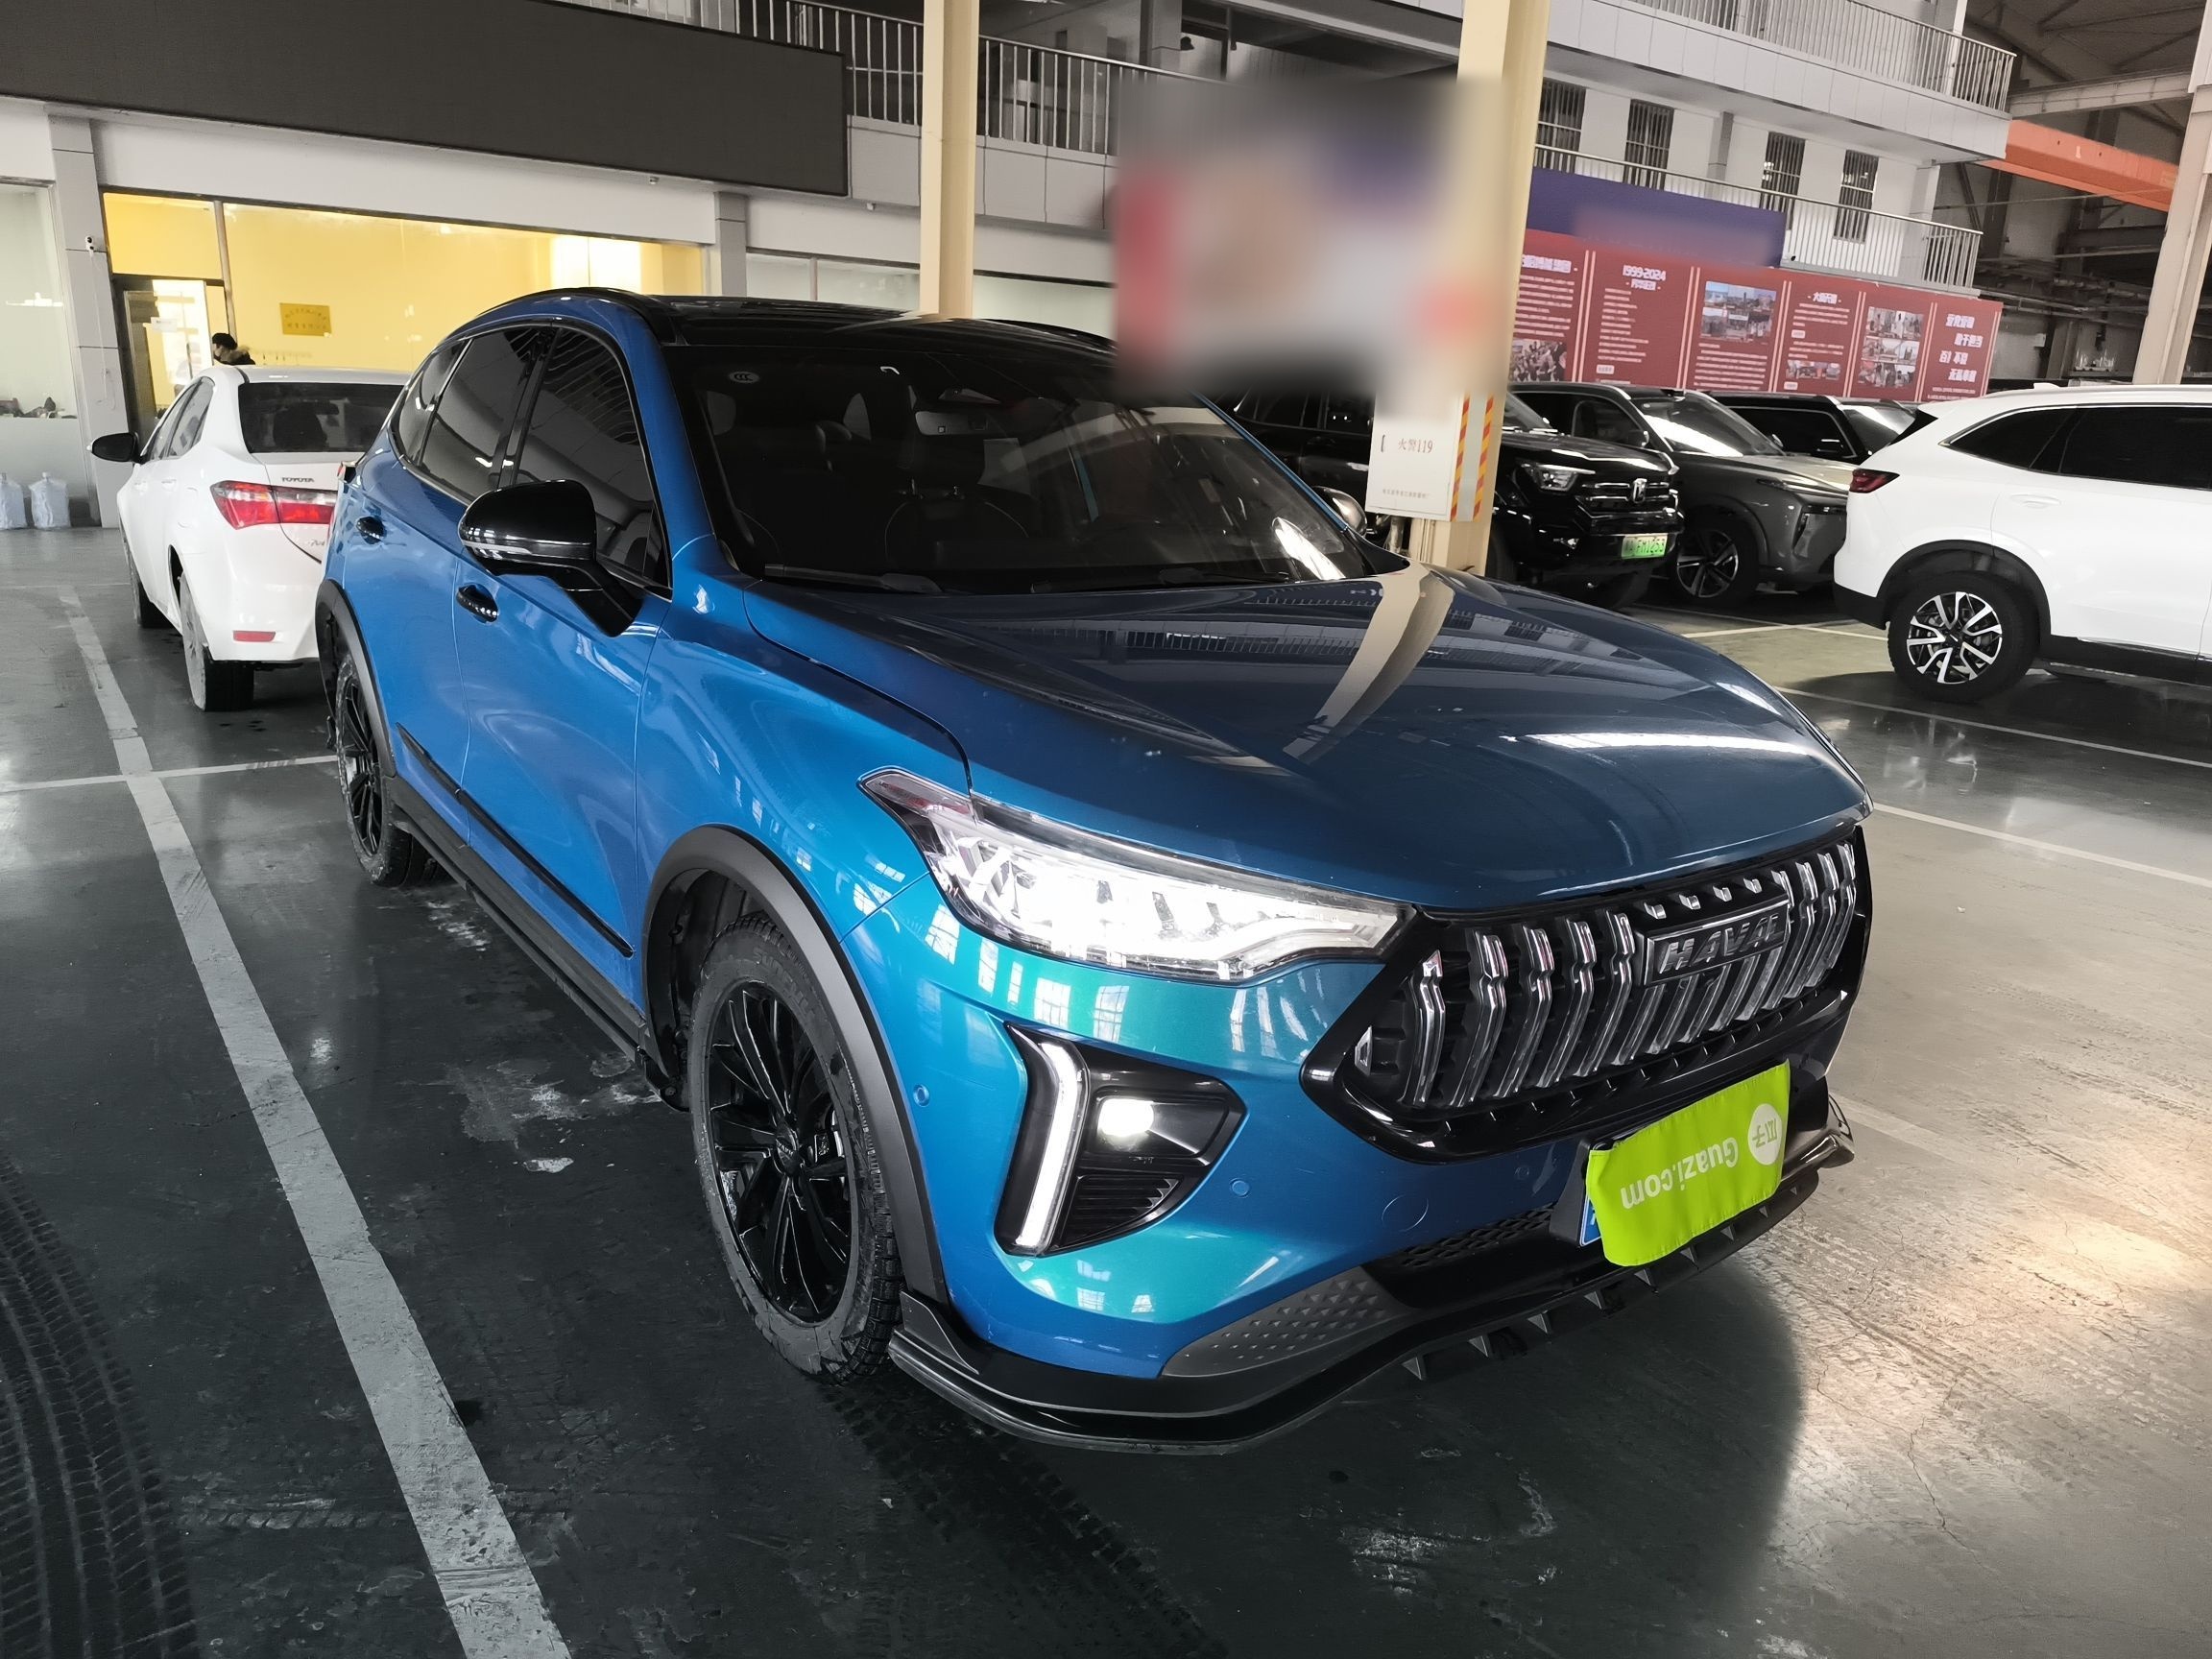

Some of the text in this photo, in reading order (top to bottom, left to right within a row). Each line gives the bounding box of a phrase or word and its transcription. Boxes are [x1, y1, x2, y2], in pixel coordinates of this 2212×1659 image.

[1623, 264, 1667, 281] 1999-2024
[1398, 437, 1433, 453] 火警119
[1751, 1118, 1778, 1147] 瓜子
[1620, 1137, 1739, 1209] Guazi.com
